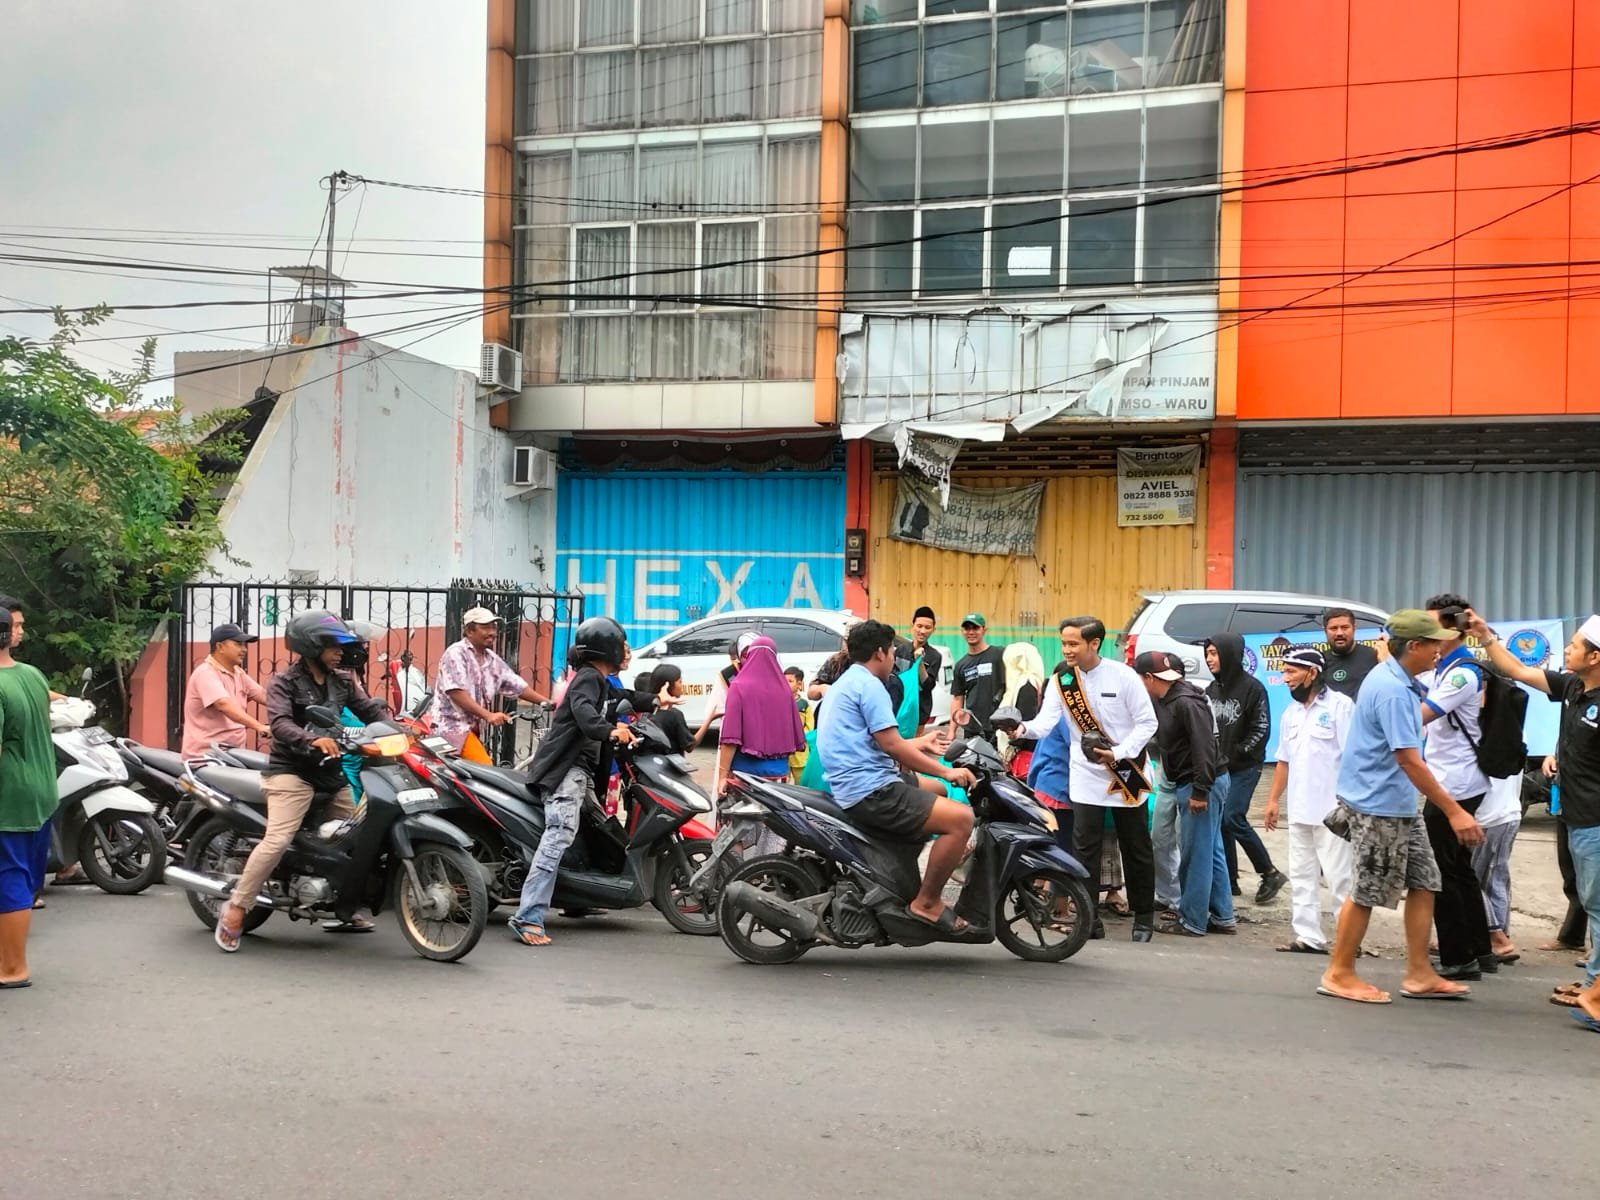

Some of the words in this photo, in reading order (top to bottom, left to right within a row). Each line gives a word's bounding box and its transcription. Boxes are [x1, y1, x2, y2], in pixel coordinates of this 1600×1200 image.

[1160, 377, 1209, 387] PINJAM
[1165, 399, 1207, 409] WARU
[1135, 451, 1183, 463] Brighton
[1126, 468, 1193, 478] DISEWAKAN
[1140, 481, 1179, 491] AVIEL
[1123, 492, 1146, 500] 0822
[1147, 491, 1171, 499] 8888
[567, 558, 823, 621] HEXA
